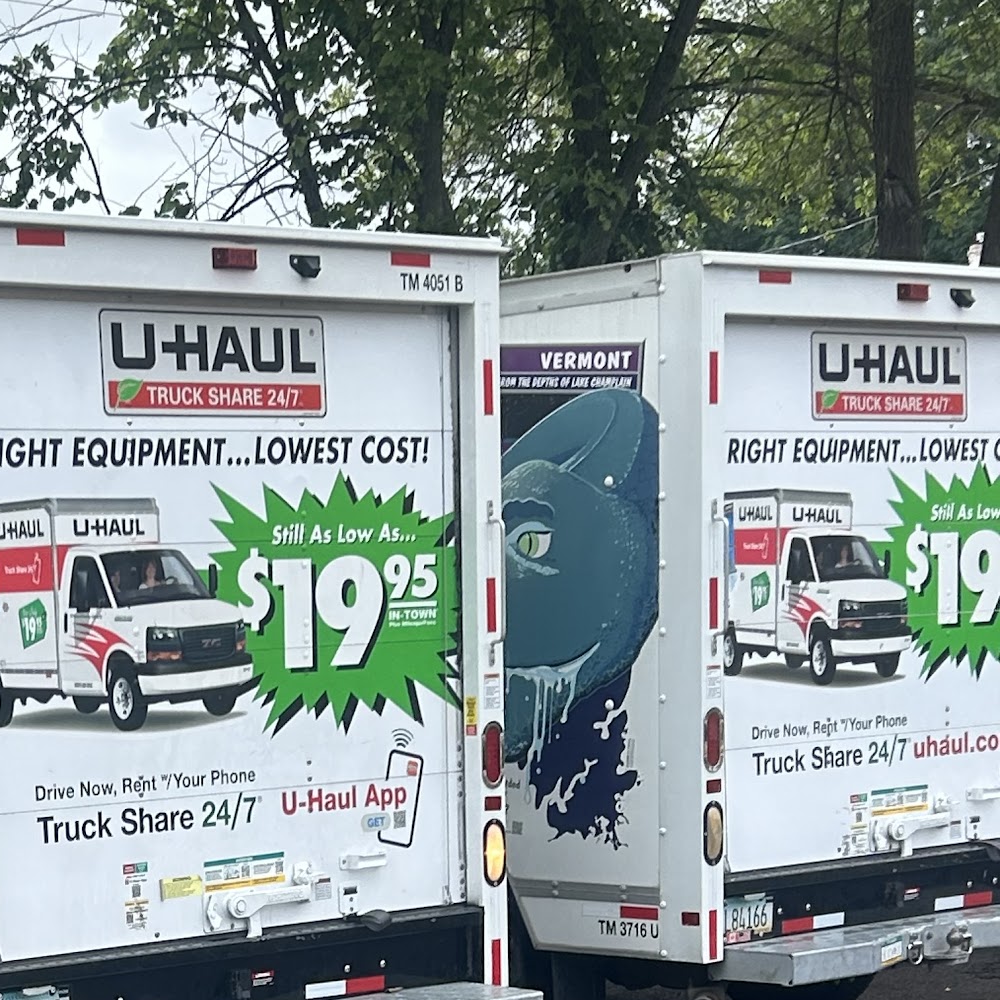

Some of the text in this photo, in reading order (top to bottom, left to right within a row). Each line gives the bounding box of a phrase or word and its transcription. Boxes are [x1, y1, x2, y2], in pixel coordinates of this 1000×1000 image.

[400, 273, 464, 292] TM 4051 B
[111, 322, 316, 373] U-HAUL
[540, 350, 633, 370] VERMONT
[819, 343, 961, 384] U-HAUL
[147, 386, 299, 407] TRUCK SHARE 24/7
[841, 395, 949, 412] TRUCK SHARE 24/7
[361, 435, 429, 464] COST!
[727, 438, 787, 464] RIGHT
[793, 507, 843, 523] U-HAUL
[930, 503, 955, 521] Still
[957, 504, 973, 520] As
[73, 518, 145, 537] U-HAUL
[272, 523, 416, 545] Still As Low As...
[388, 609, 436, 620] IN-TOWN
[752, 726, 780, 740] Drive
[783, 723, 810, 738] Now,
[875, 714, 908, 729] Phone
[753, 749, 806, 776] Truck
[812, 745, 863, 770] Share
[868, 733, 907, 767] 24/7
[35, 784, 74, 801] Drive
[80, 781, 118, 797] Now,
[122, 776, 157, 793] Rent
[210, 769, 256, 785] Phone
[281, 783, 408, 815] U-Haul App
[37, 792, 257, 844] Truck Share 24/7
[367, 816, 385, 828] GET
[598, 920, 659, 938] TM 3716 U
